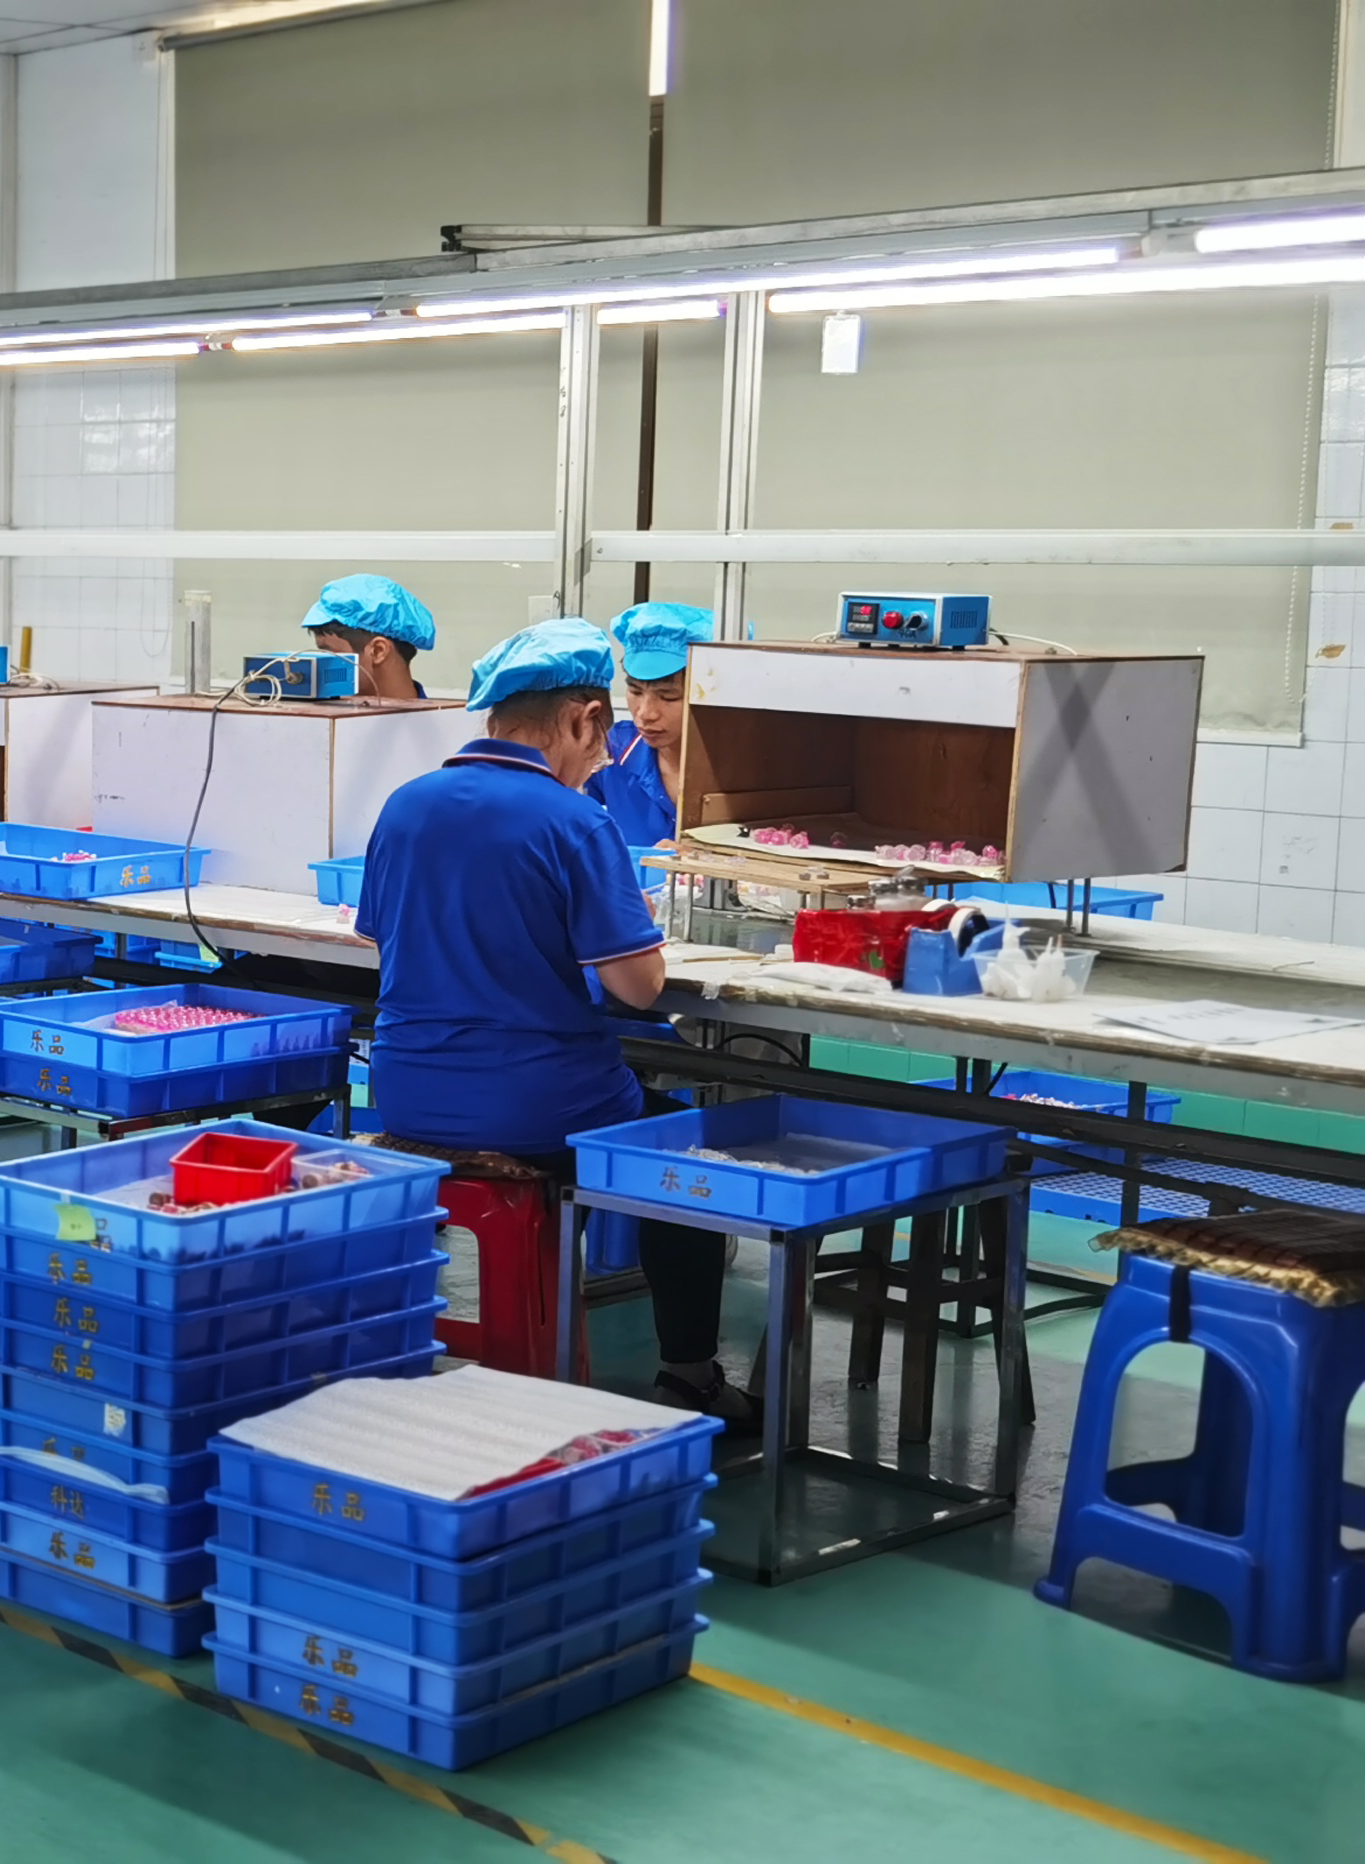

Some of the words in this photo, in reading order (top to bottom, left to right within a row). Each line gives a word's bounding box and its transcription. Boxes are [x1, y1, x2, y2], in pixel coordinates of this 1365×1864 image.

[31, 1029, 65, 1055] 乐品
[38, 1069, 72, 1096] 乐品
[660, 1165, 712, 1198] 乐品
[48, 1254, 92, 1285] 乐品
[54, 1297, 99, 1333] 乐品
[51, 1345, 95, 1380] 乐品
[312, 1484, 365, 1521] 乐品
[49, 1532, 96, 1569] 乐品
[303, 1636, 359, 1678] 乐品
[300, 1685, 355, 1725] 乐品
